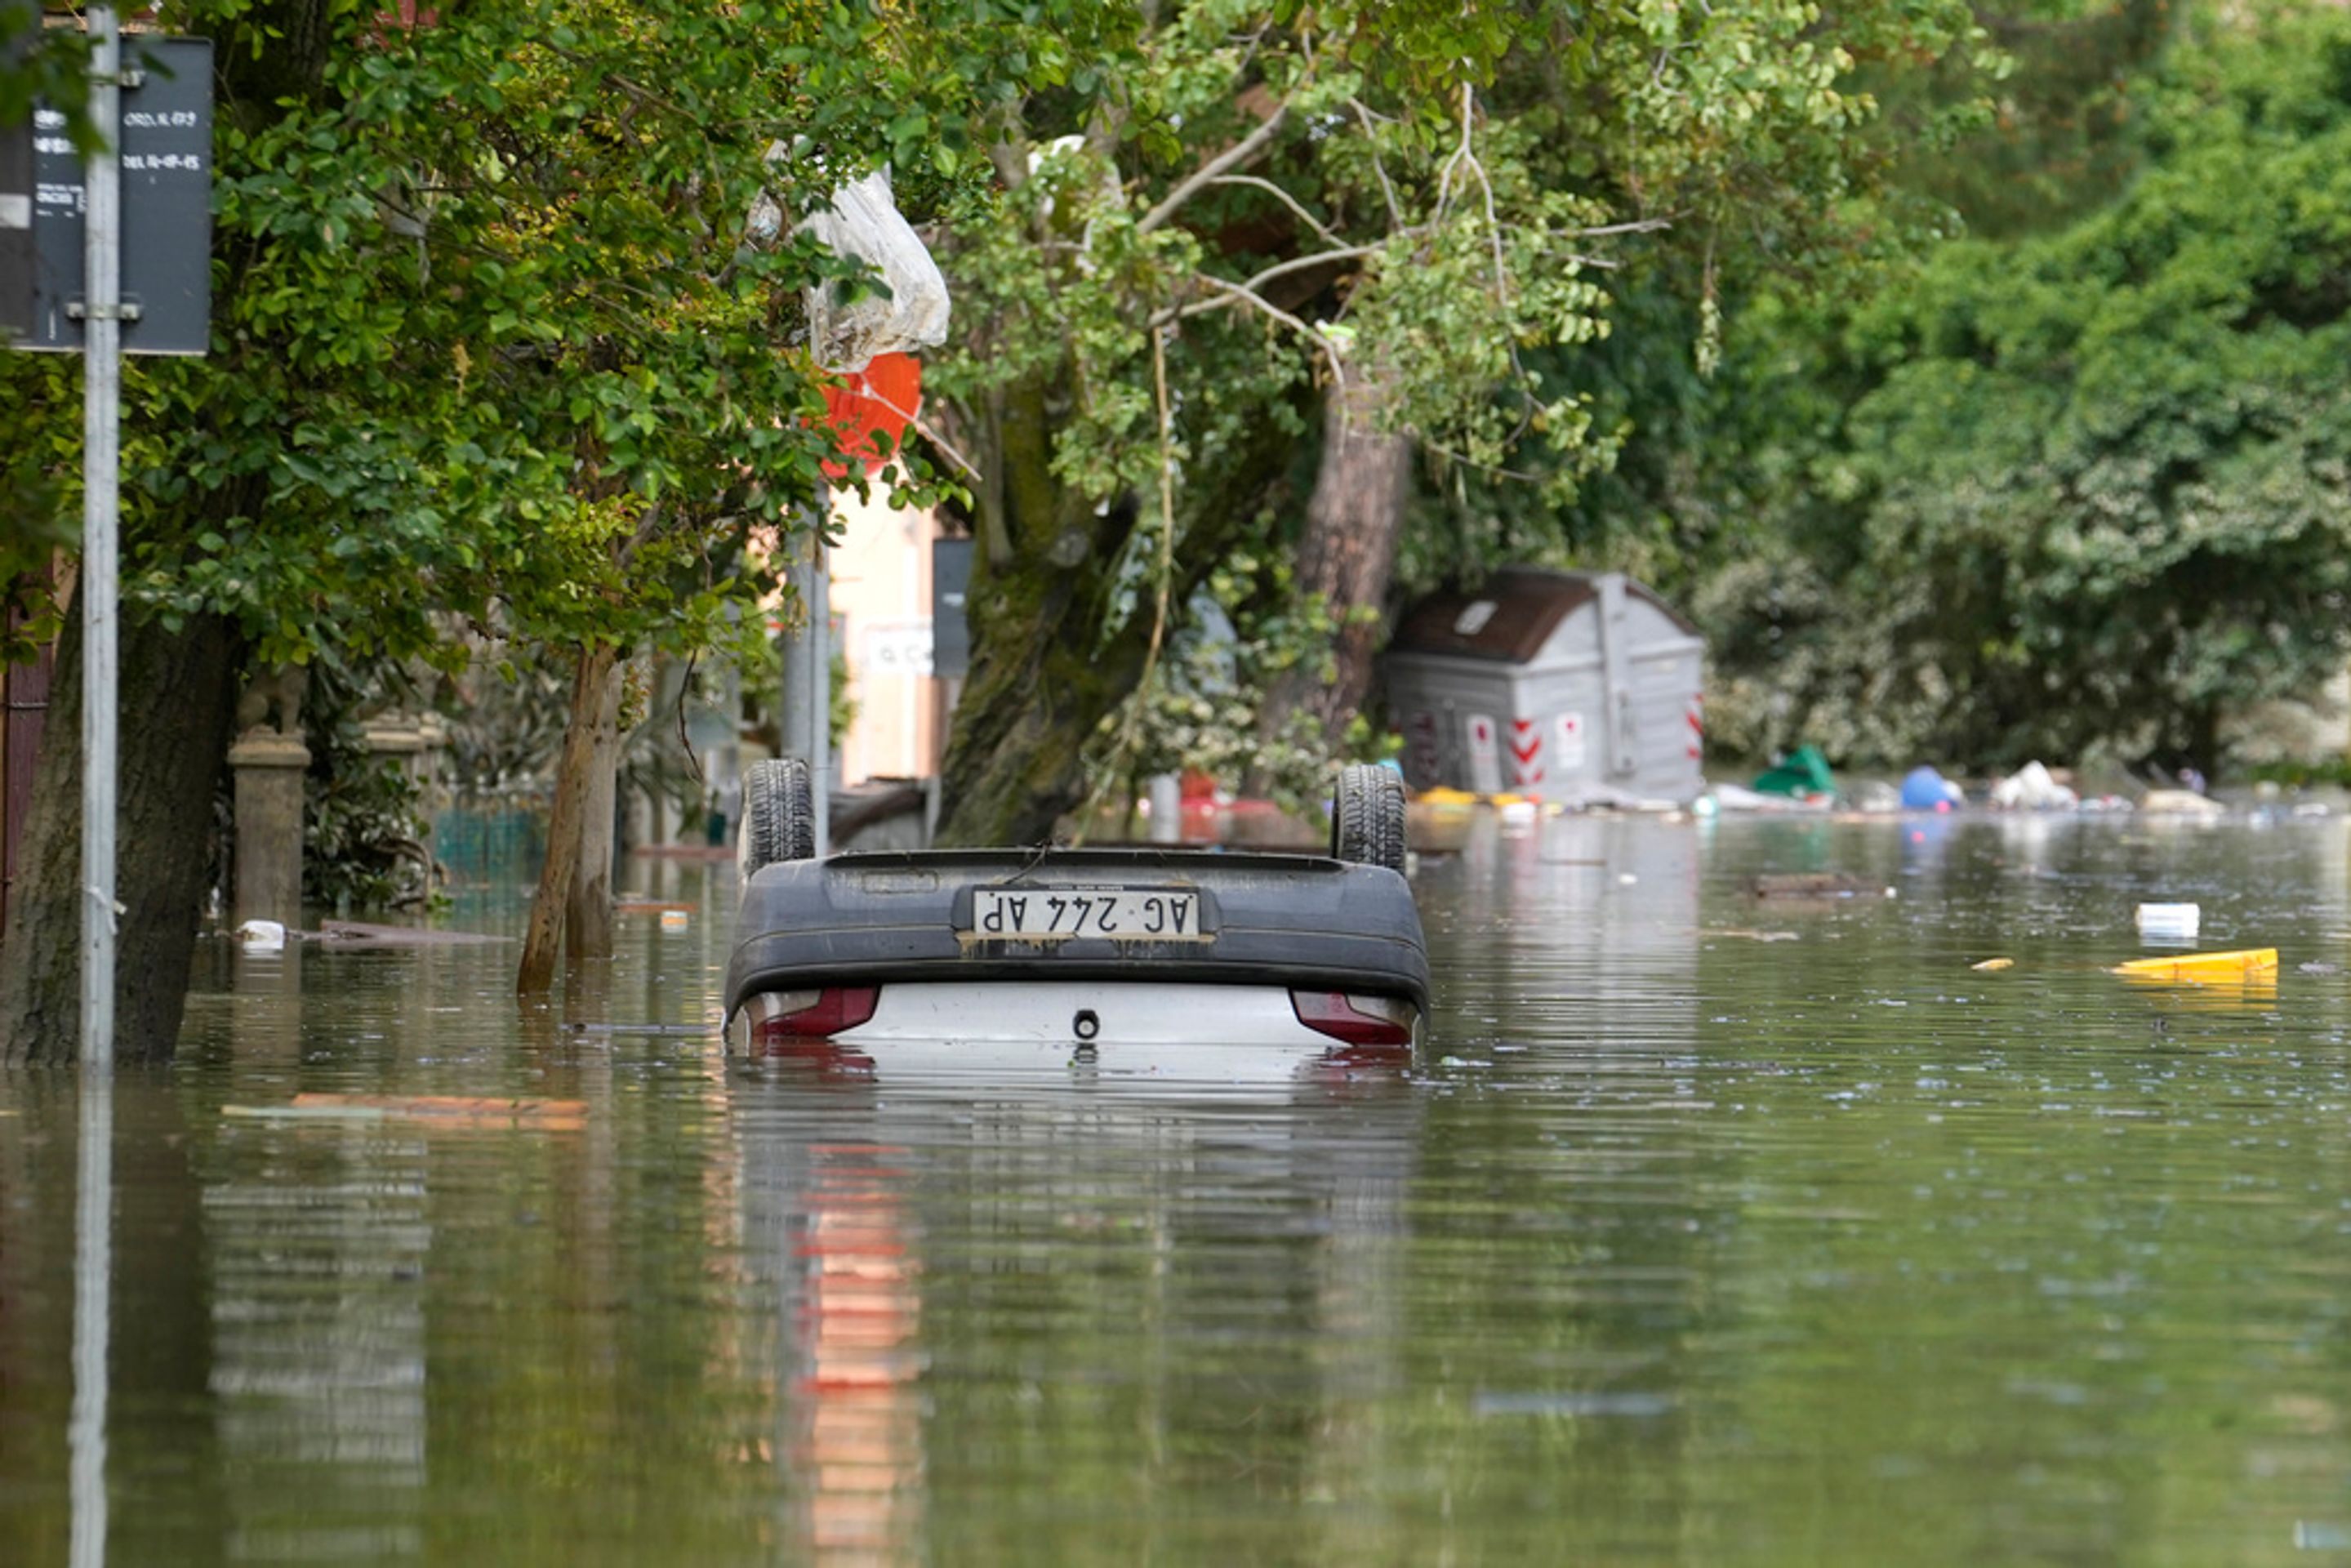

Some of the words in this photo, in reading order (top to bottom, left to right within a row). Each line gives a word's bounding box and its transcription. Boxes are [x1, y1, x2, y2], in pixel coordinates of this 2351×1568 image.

[983, 897, 1027, 932] AP
[1047, 898, 1117, 932] 244
[1144, 898, 1188, 933] AG
